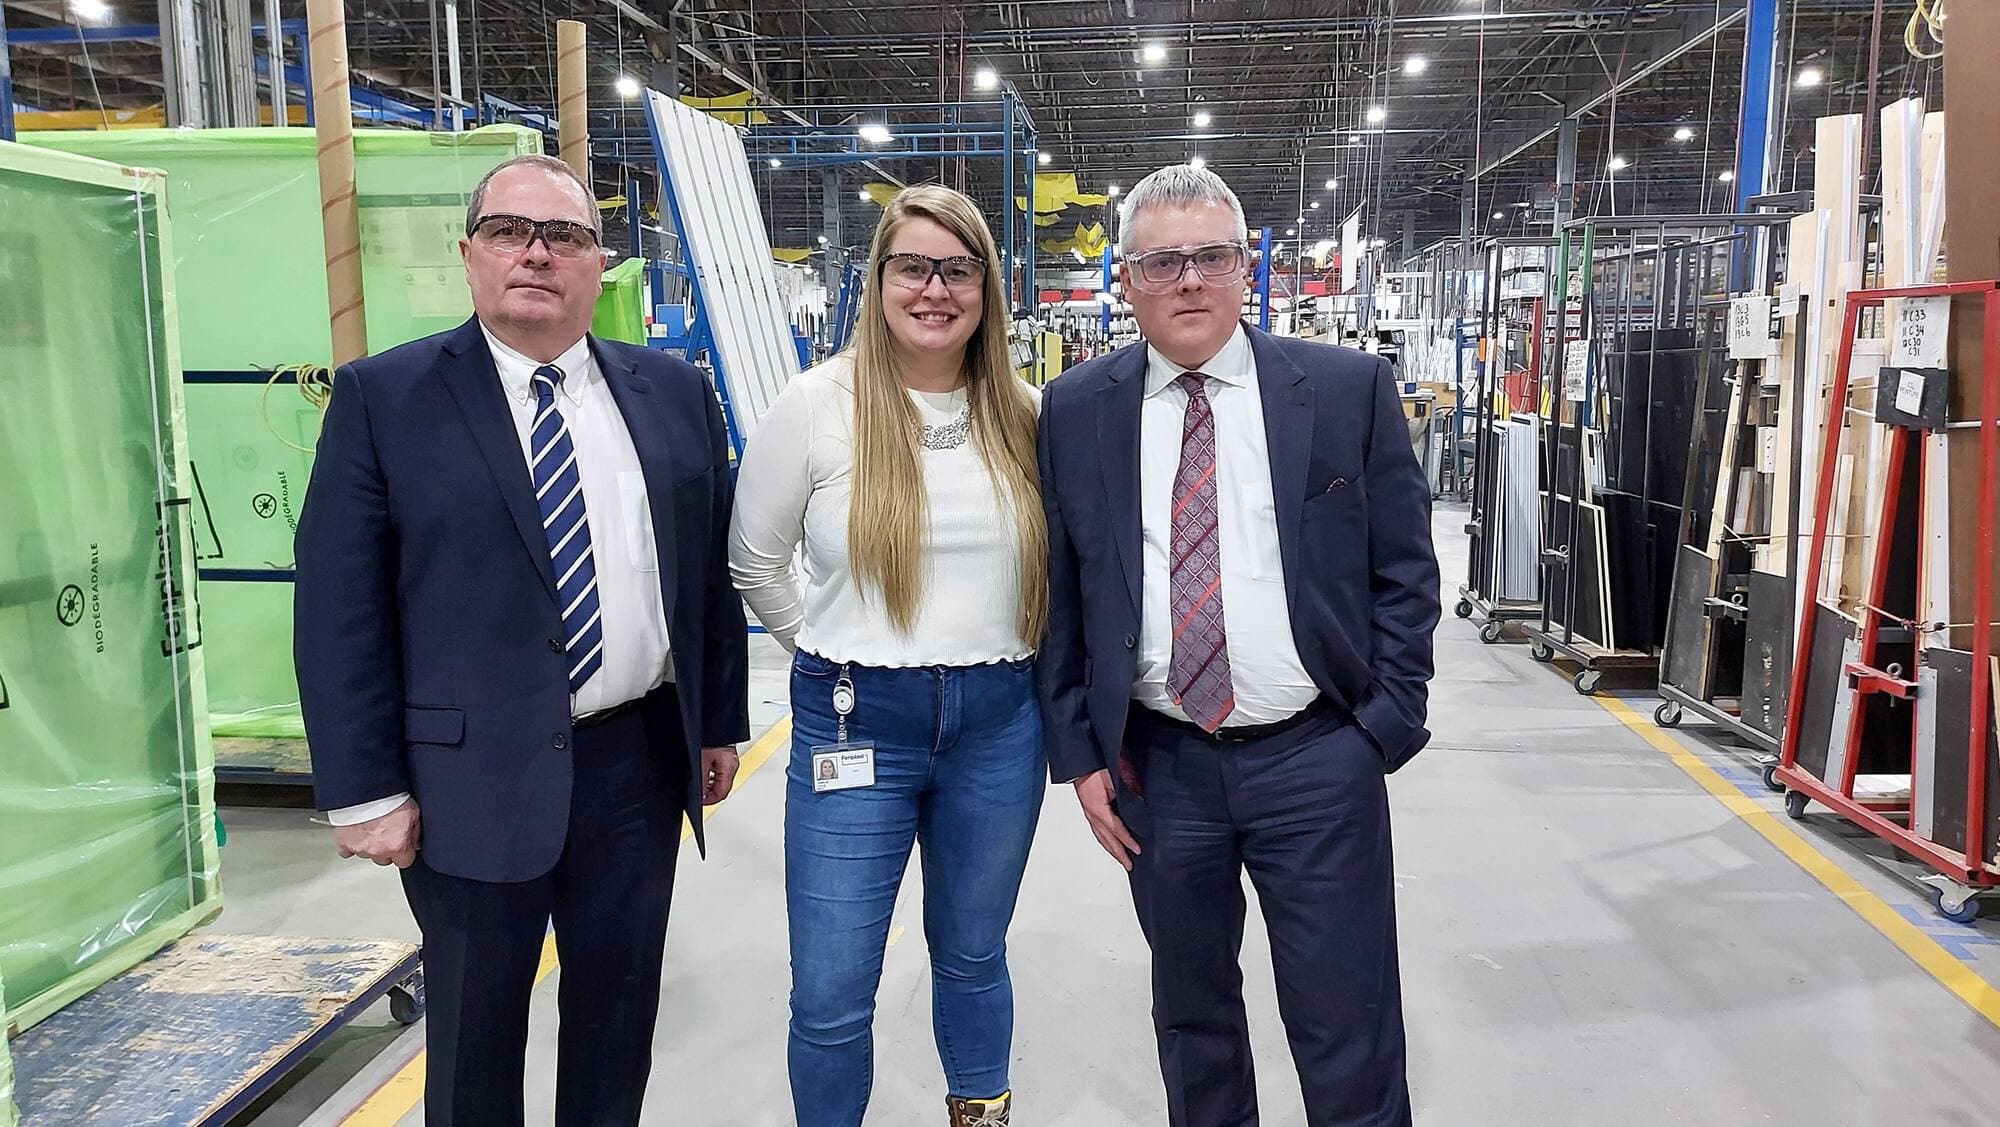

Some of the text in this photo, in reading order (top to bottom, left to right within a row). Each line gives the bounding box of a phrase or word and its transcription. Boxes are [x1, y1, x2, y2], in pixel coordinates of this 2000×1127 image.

[664, 250, 672, 260] 2
[1910, 309, 1926, 321] C33
[1909, 324, 1924, 337] C34
[90, 542, 104, 654] BIODÉGRADABLE
